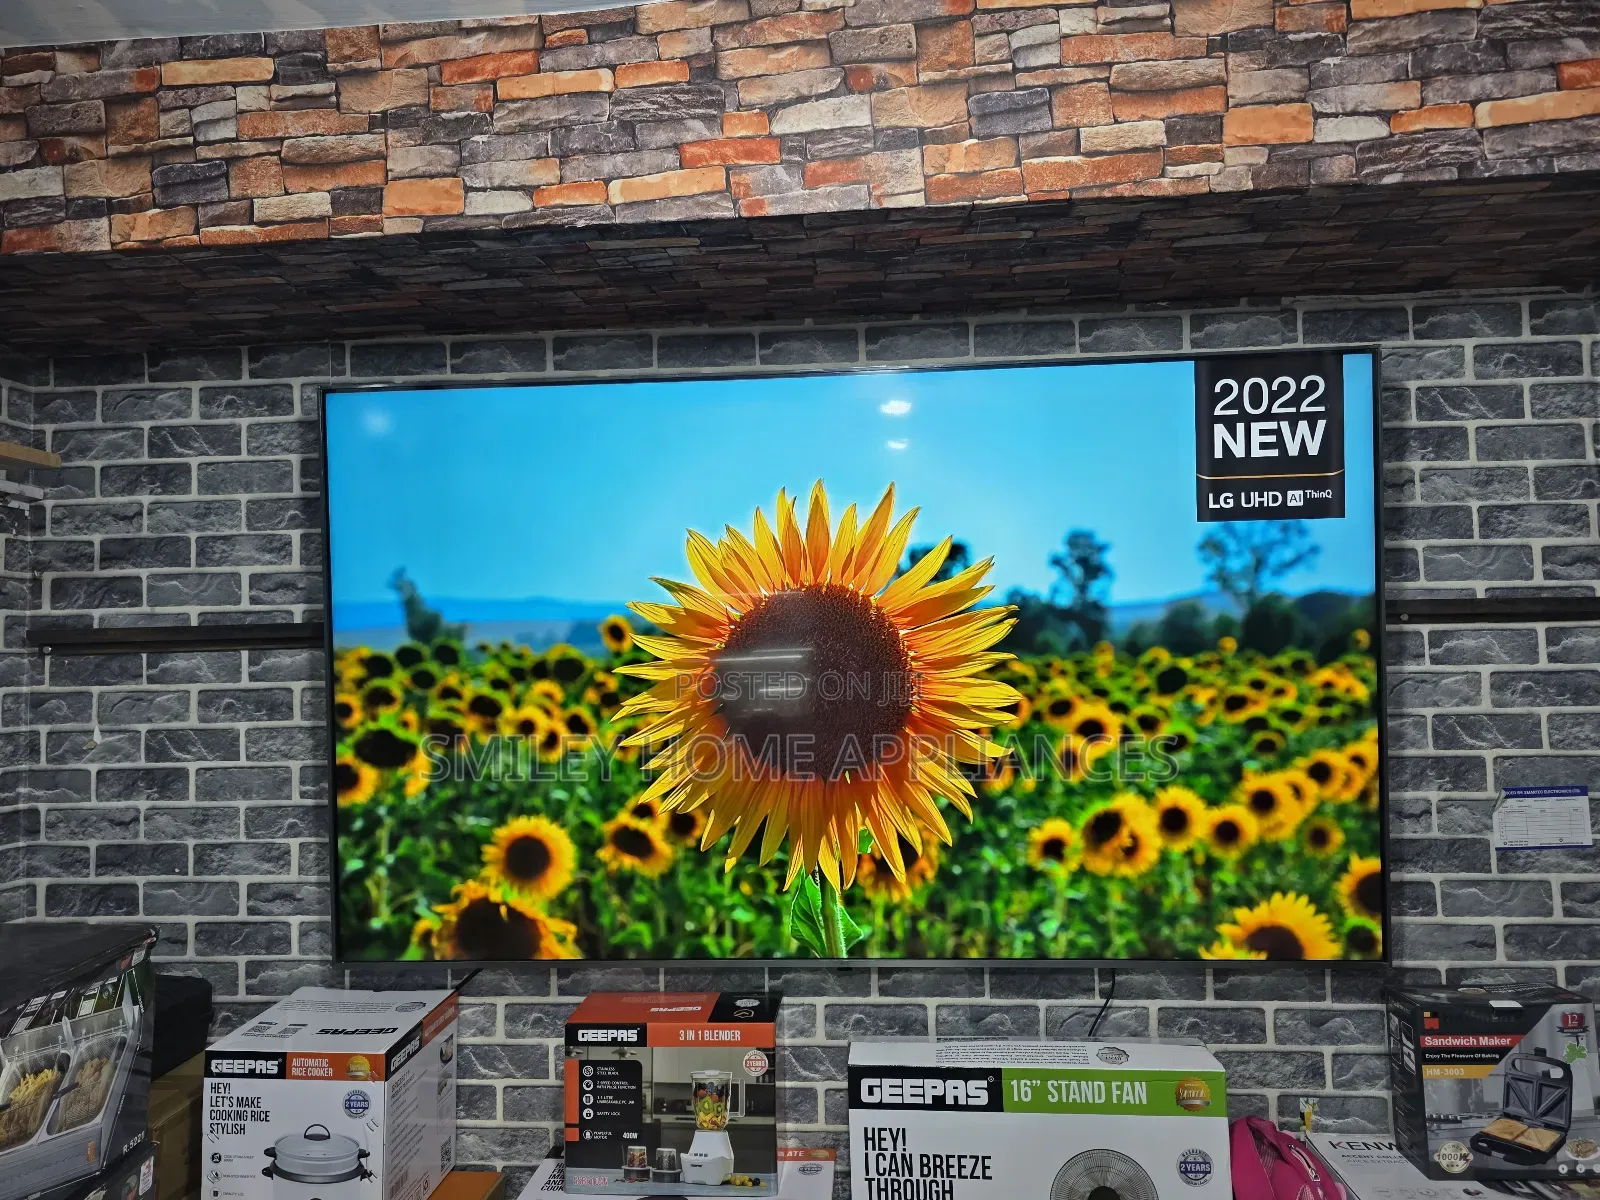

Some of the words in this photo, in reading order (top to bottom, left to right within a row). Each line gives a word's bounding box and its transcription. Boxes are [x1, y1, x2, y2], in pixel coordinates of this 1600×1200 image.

[1214, 375, 1326, 416] 2022
[1214, 420, 1327, 459] NEW
[1208, 492, 1234, 509] LG
[1241, 491, 1283, 508] UHD
[1288, 491, 1303, 506] AI
[1304, 490, 1332, 499] ThinQ
[1567, 1014, 1579, 1024] 12
[316, 1027, 399, 1035] GEEPAS
[577, 1029, 638, 1042] GEEPAS
[679, 1030, 685, 1041] 3
[686, 1030, 695, 1041] IN
[698, 1030, 702, 1041] 1
[704, 1030, 741, 1042] BLENDER
[1424, 1036, 1478, 1047] Sandwich
[1479, 1036, 1512, 1046] Maker
[390, 1035, 420, 1072] GEEPAS
[210, 1059, 279, 1075] GEEPAS
[291, 1058, 329, 1067] AUTOMATIC
[292, 1067, 306, 1076] RICE
[307, 1068, 333, 1077] COOKER
[1426, 1068, 1465, 1076] HM-3003
[210, 1082, 231, 1095] HEY!
[860, 1077, 989, 1106] GEEPAS
[1047, 1080, 1106, 1104] STAND
[1111, 1081, 1148, 1105] FAN
[210, 1096, 234, 1108] LET'S
[236, 1096, 262, 1109] MAKE
[209, 1110, 248, 1122] COOKING
[250, 1110, 270, 1122] RICE
[209, 1122, 246, 1136] STYLISH
[863, 1126, 907, 1152] HEY!
[864, 1152, 870, 1177] I
[875, 1152, 914, 1178] CAN
[919, 1153, 993, 1180] BREEZE
[1180, 1163, 1186, 1172] 2
[1186, 1163, 1210, 1172] YEARS
[865, 1177, 954, 1200] THROUGH
